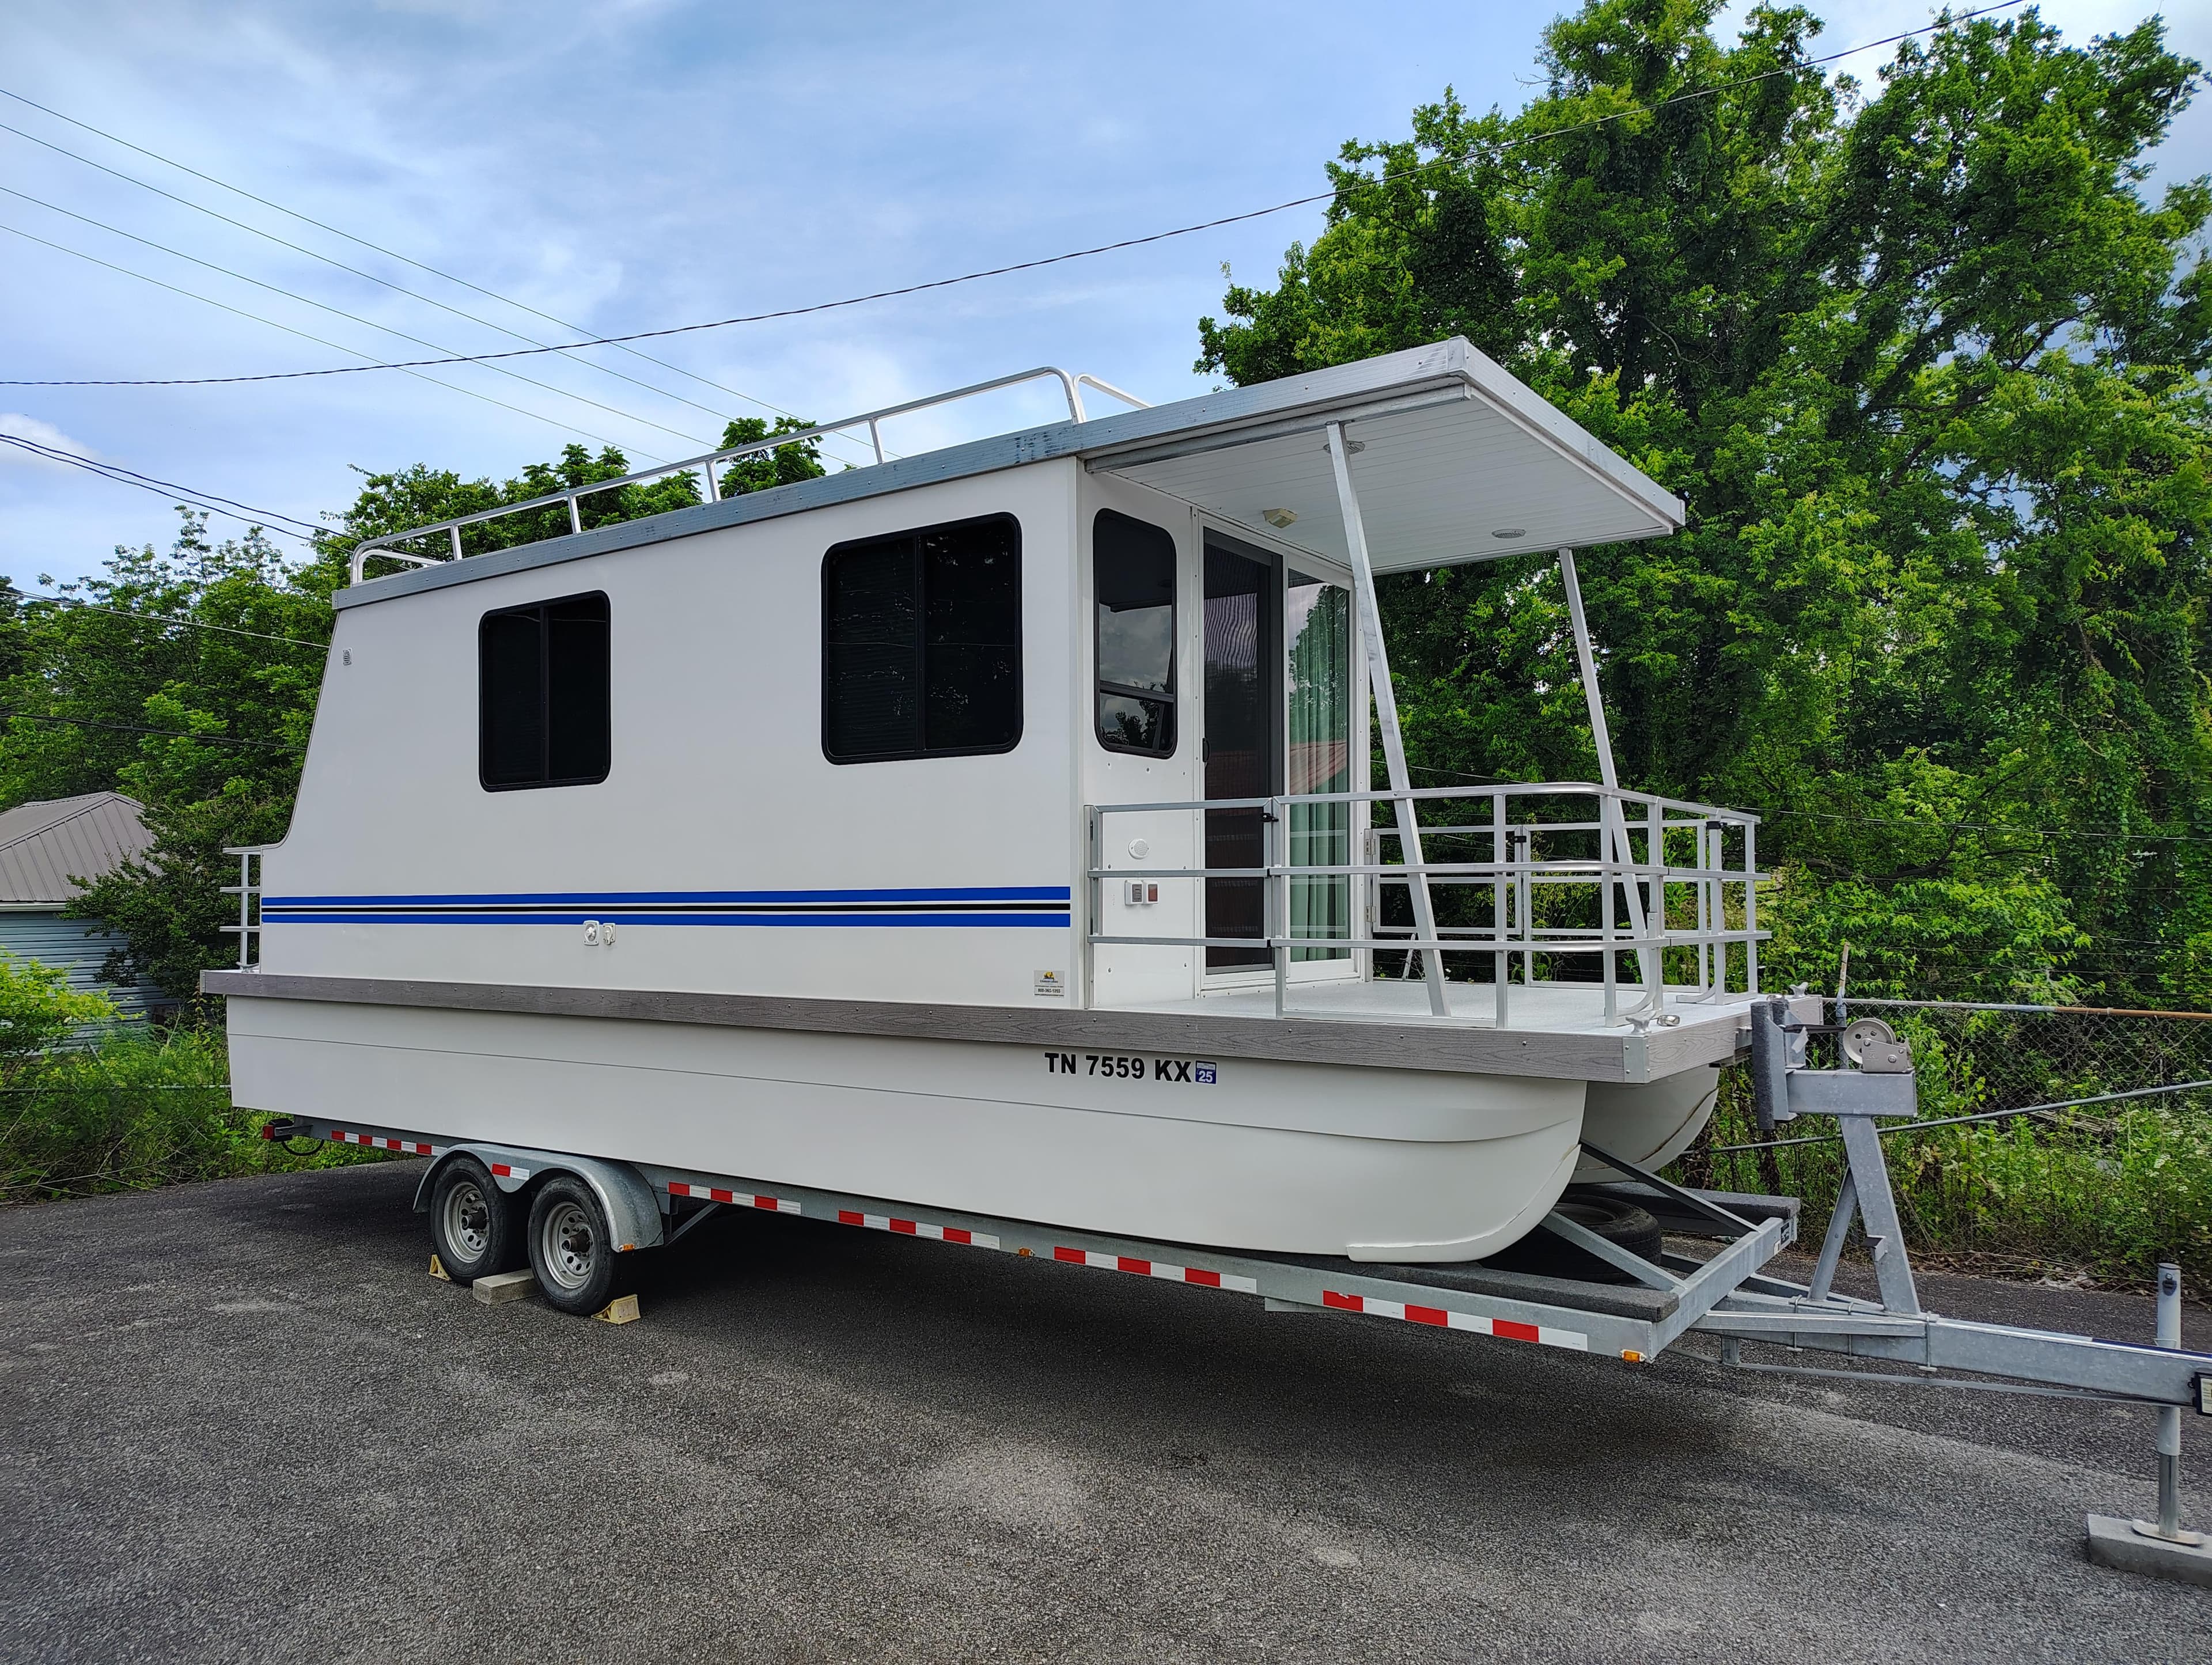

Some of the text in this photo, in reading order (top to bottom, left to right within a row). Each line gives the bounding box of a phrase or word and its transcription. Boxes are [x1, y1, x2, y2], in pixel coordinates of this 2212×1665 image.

[1044, 1052, 1192, 1083] TN 7559 KX
[1199, 1070, 1213, 1083] 25
